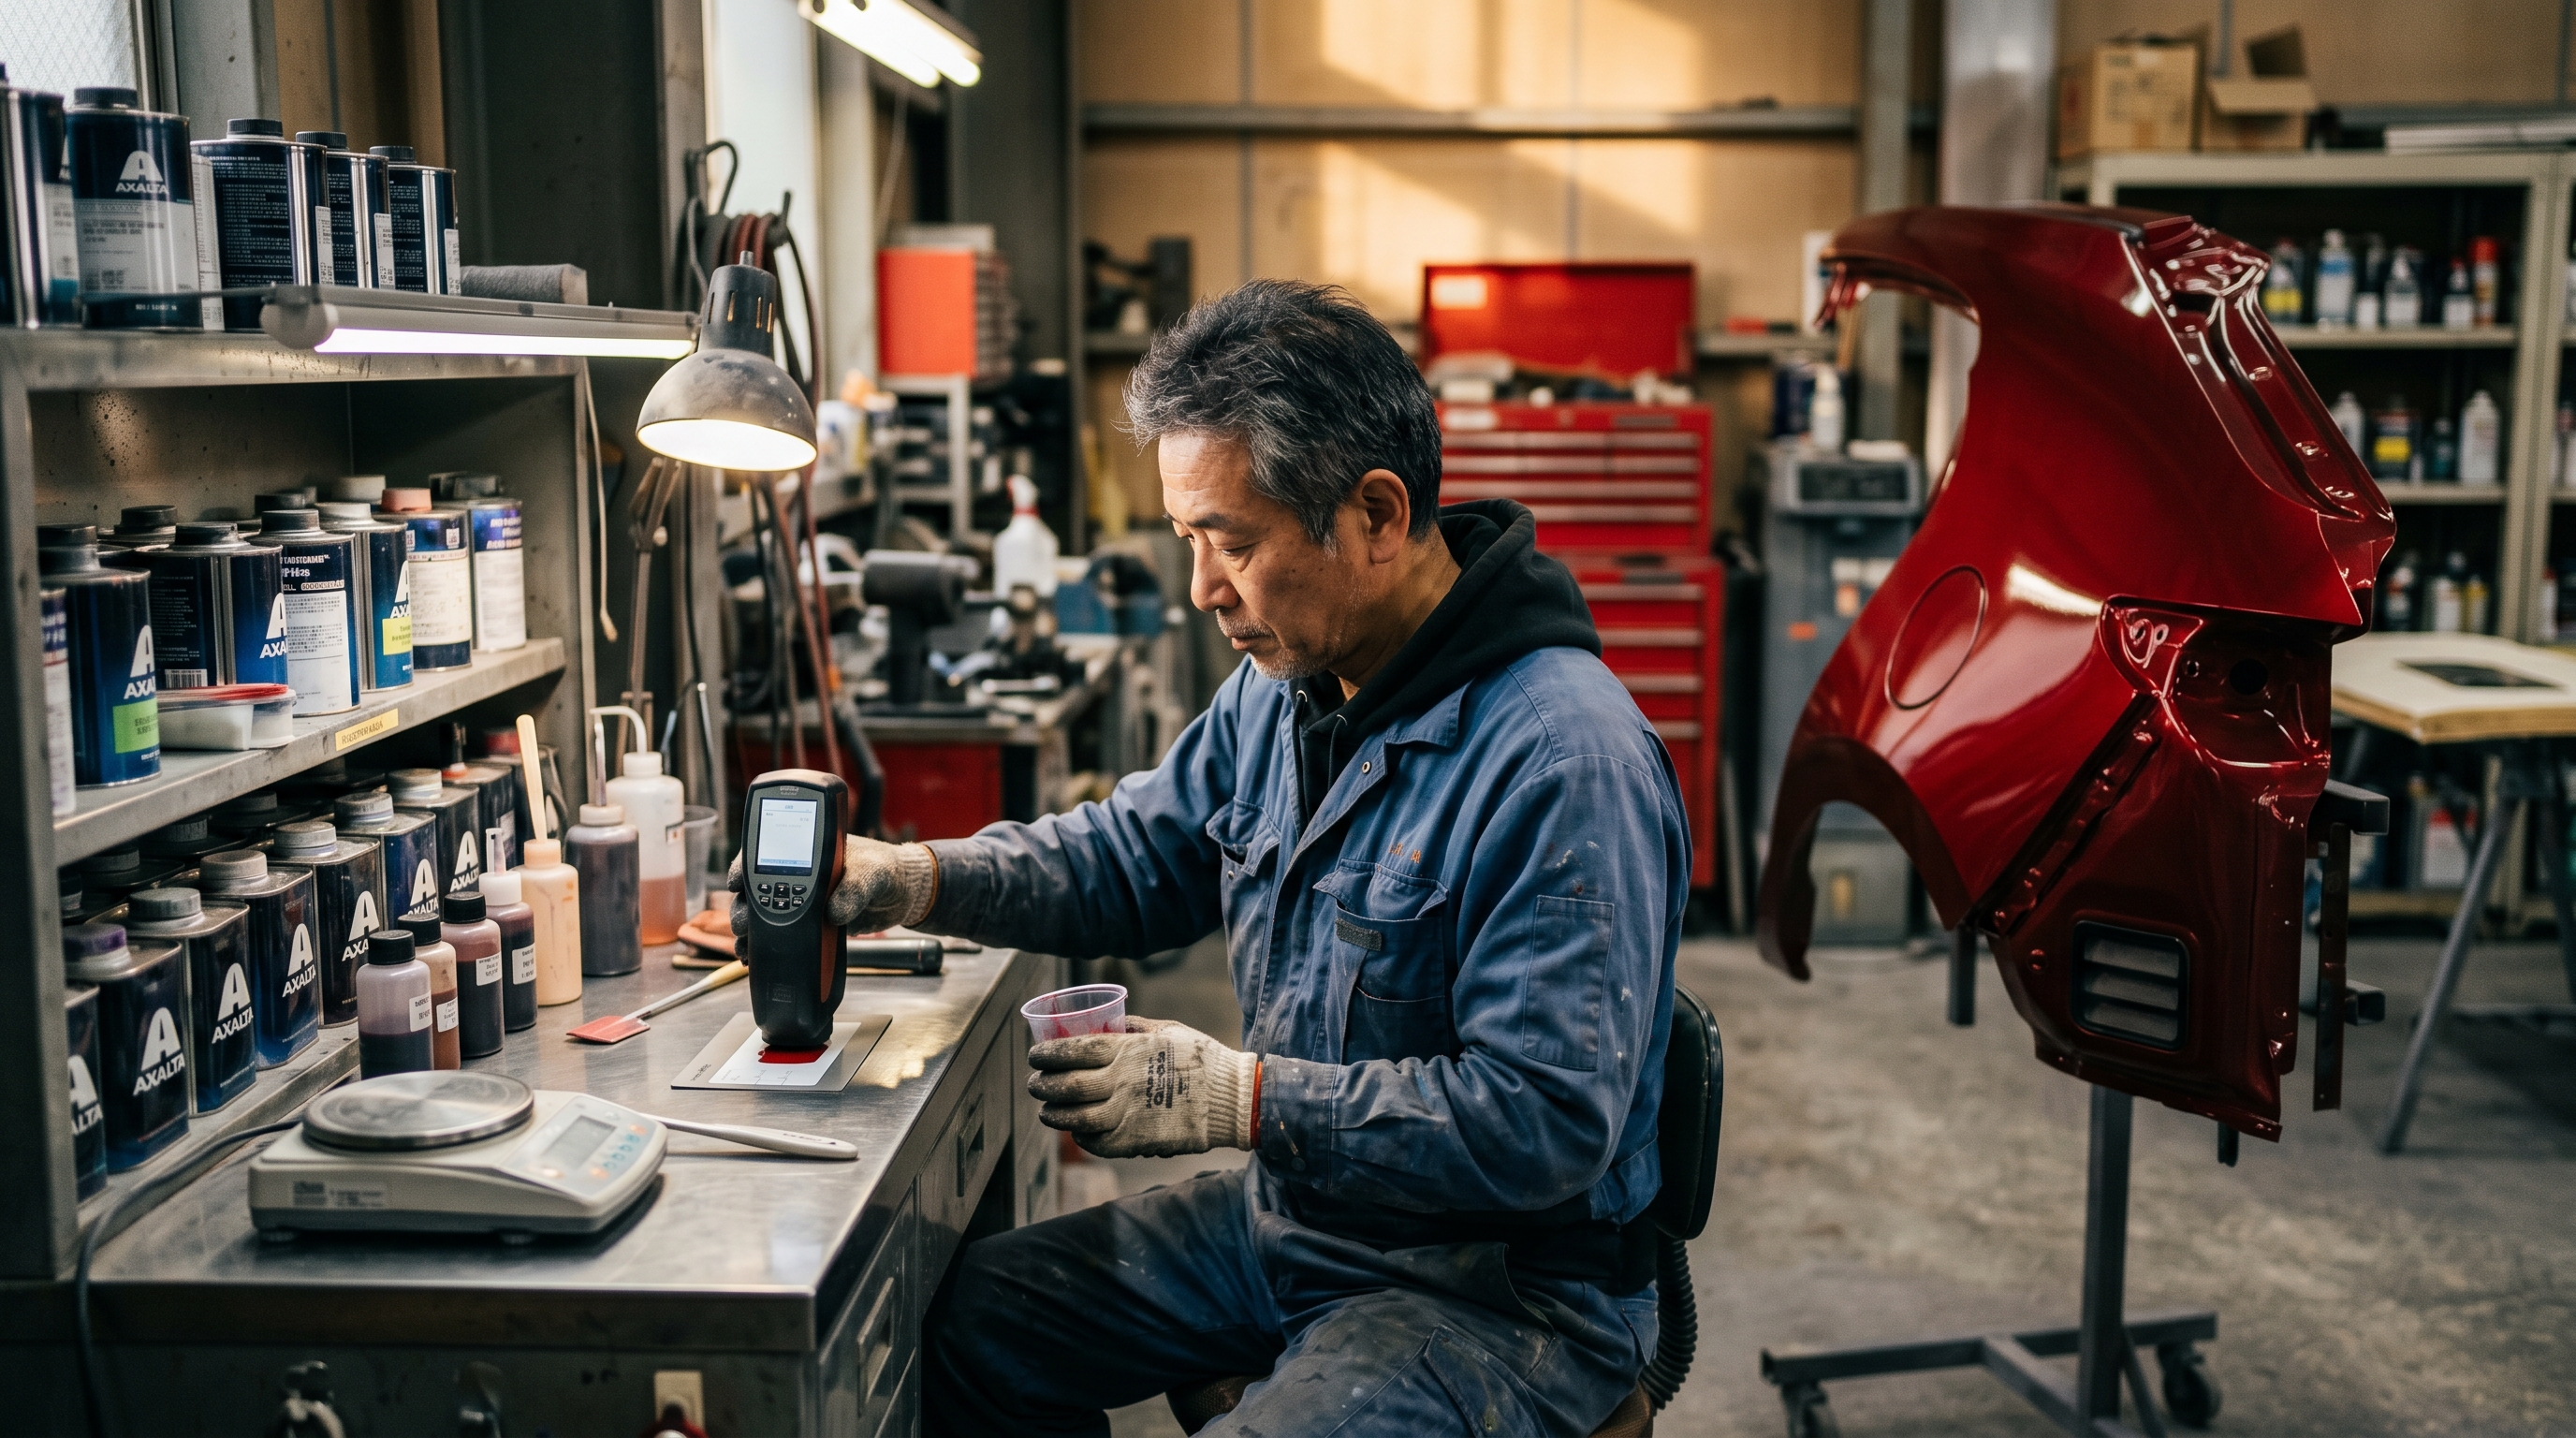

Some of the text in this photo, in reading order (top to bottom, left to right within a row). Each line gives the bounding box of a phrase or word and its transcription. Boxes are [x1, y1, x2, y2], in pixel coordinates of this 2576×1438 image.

[115, 182, 169, 195] AXALTA
[389, 602, 412, 620] AX
[259, 638, 288, 659] AXA
[407, 897, 439, 916] XALTA
[341, 938, 370, 962] AXA
[282, 963, 317, 998] AXALTA
[211, 1005, 254, 1045] AXALTA
[132, 1051, 186, 1096] AXALTA
